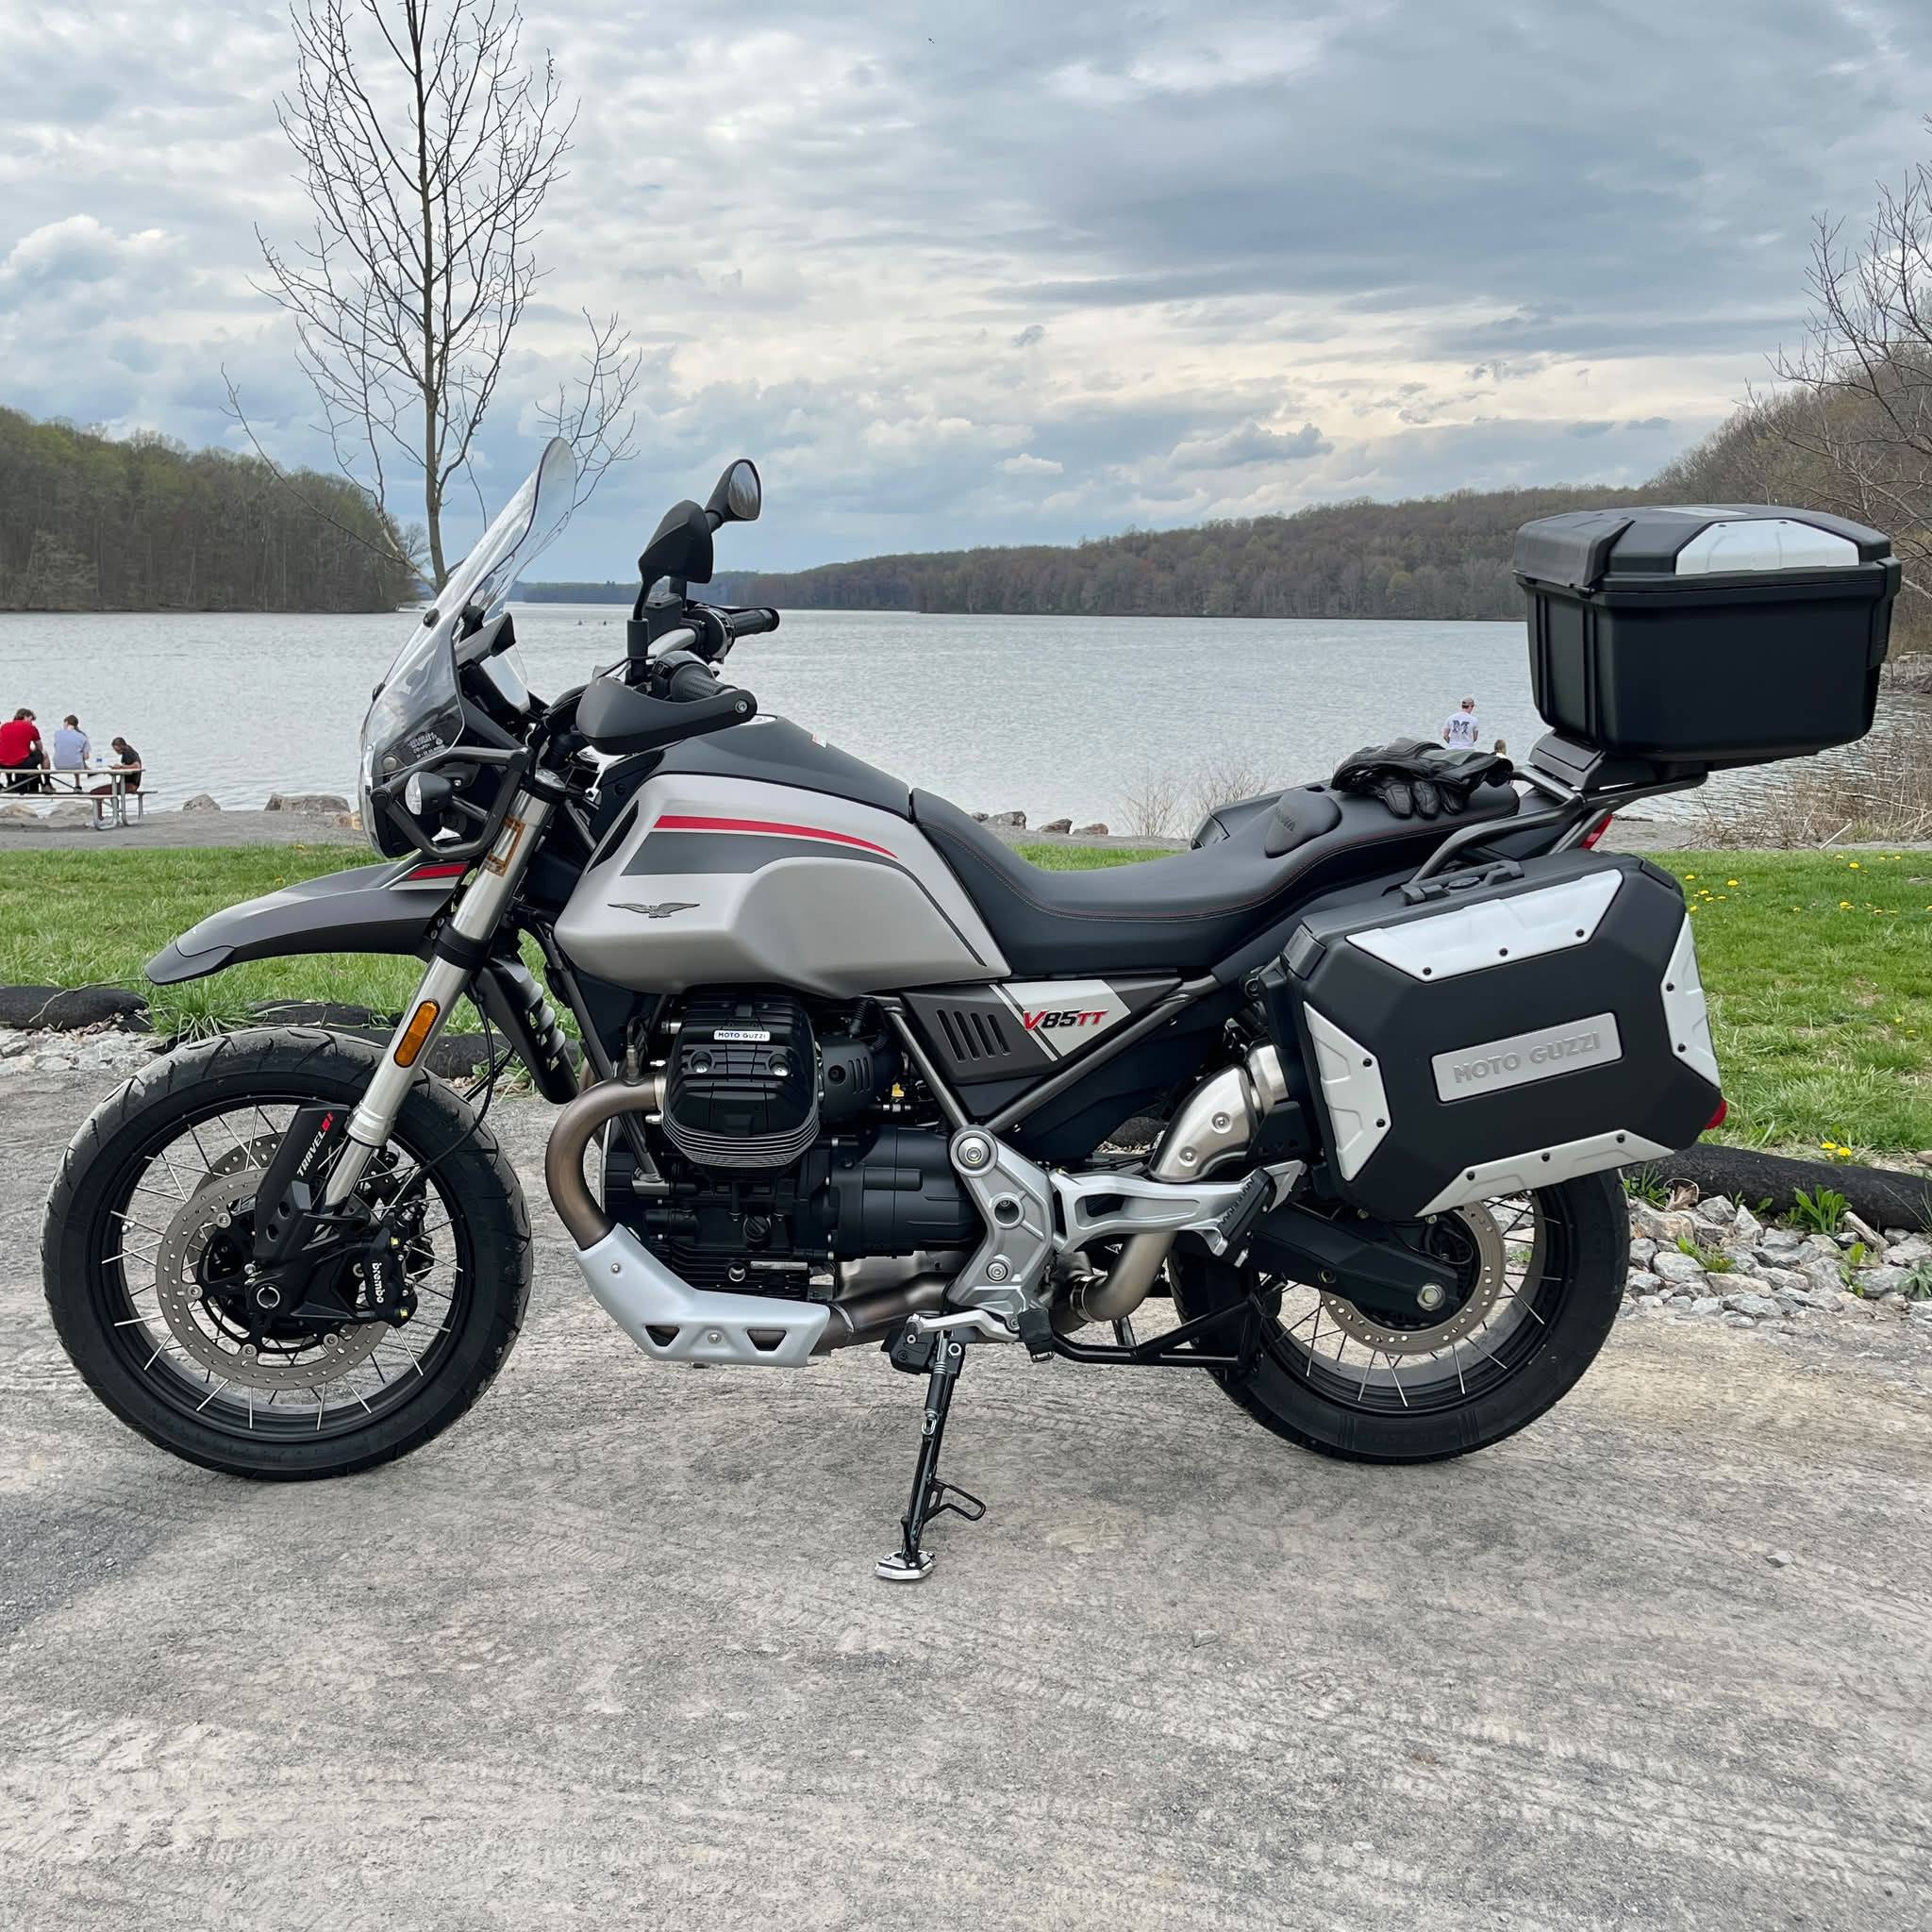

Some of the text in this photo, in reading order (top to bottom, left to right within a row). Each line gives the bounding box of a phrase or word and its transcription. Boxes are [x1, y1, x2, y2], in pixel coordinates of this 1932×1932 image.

[1023, 1009, 1109, 1030] V85TT
[1453, 1031, 1601, 1084] MOTO GUZZI
[296, 1130, 326, 1177] TRAVEL
[372, 1262, 385, 1304] brembo
